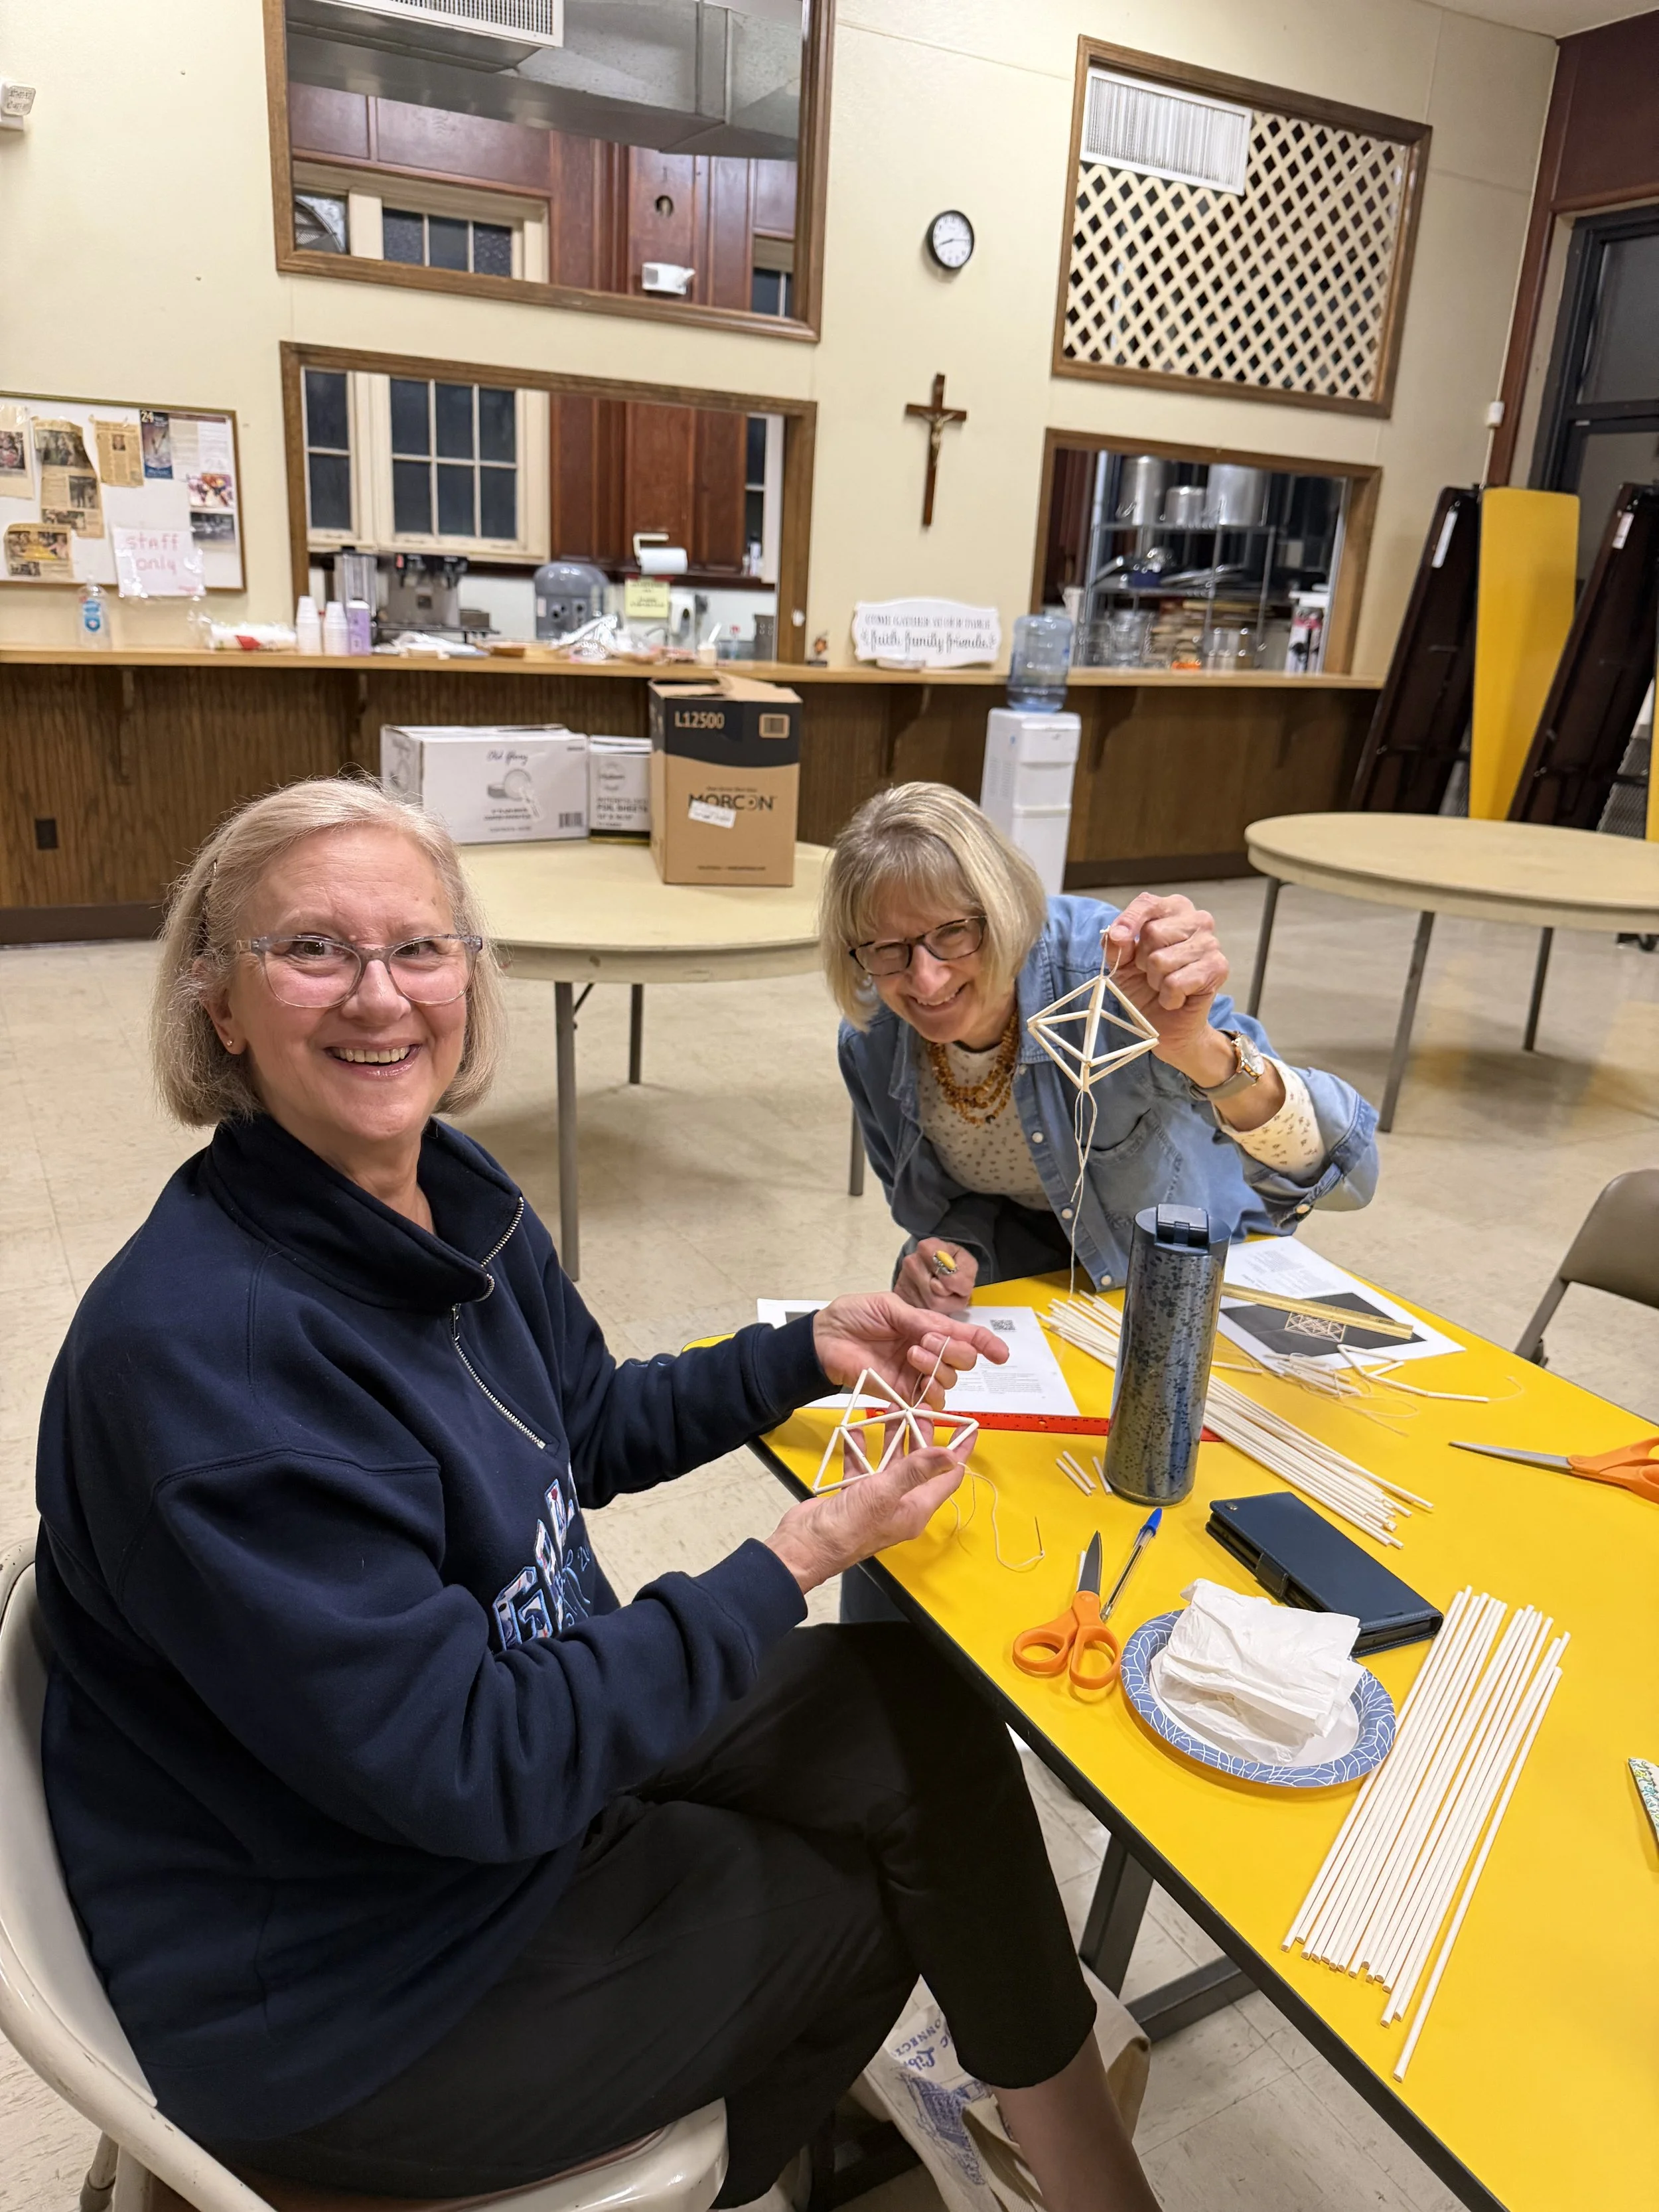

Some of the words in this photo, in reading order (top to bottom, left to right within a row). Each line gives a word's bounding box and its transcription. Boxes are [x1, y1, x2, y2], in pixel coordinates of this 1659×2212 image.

[125, 532, 179, 552] staff
[135, 555, 177, 576] only
[674, 711, 725, 729] L12500
[904, 2047, 935, 2071] Lib
